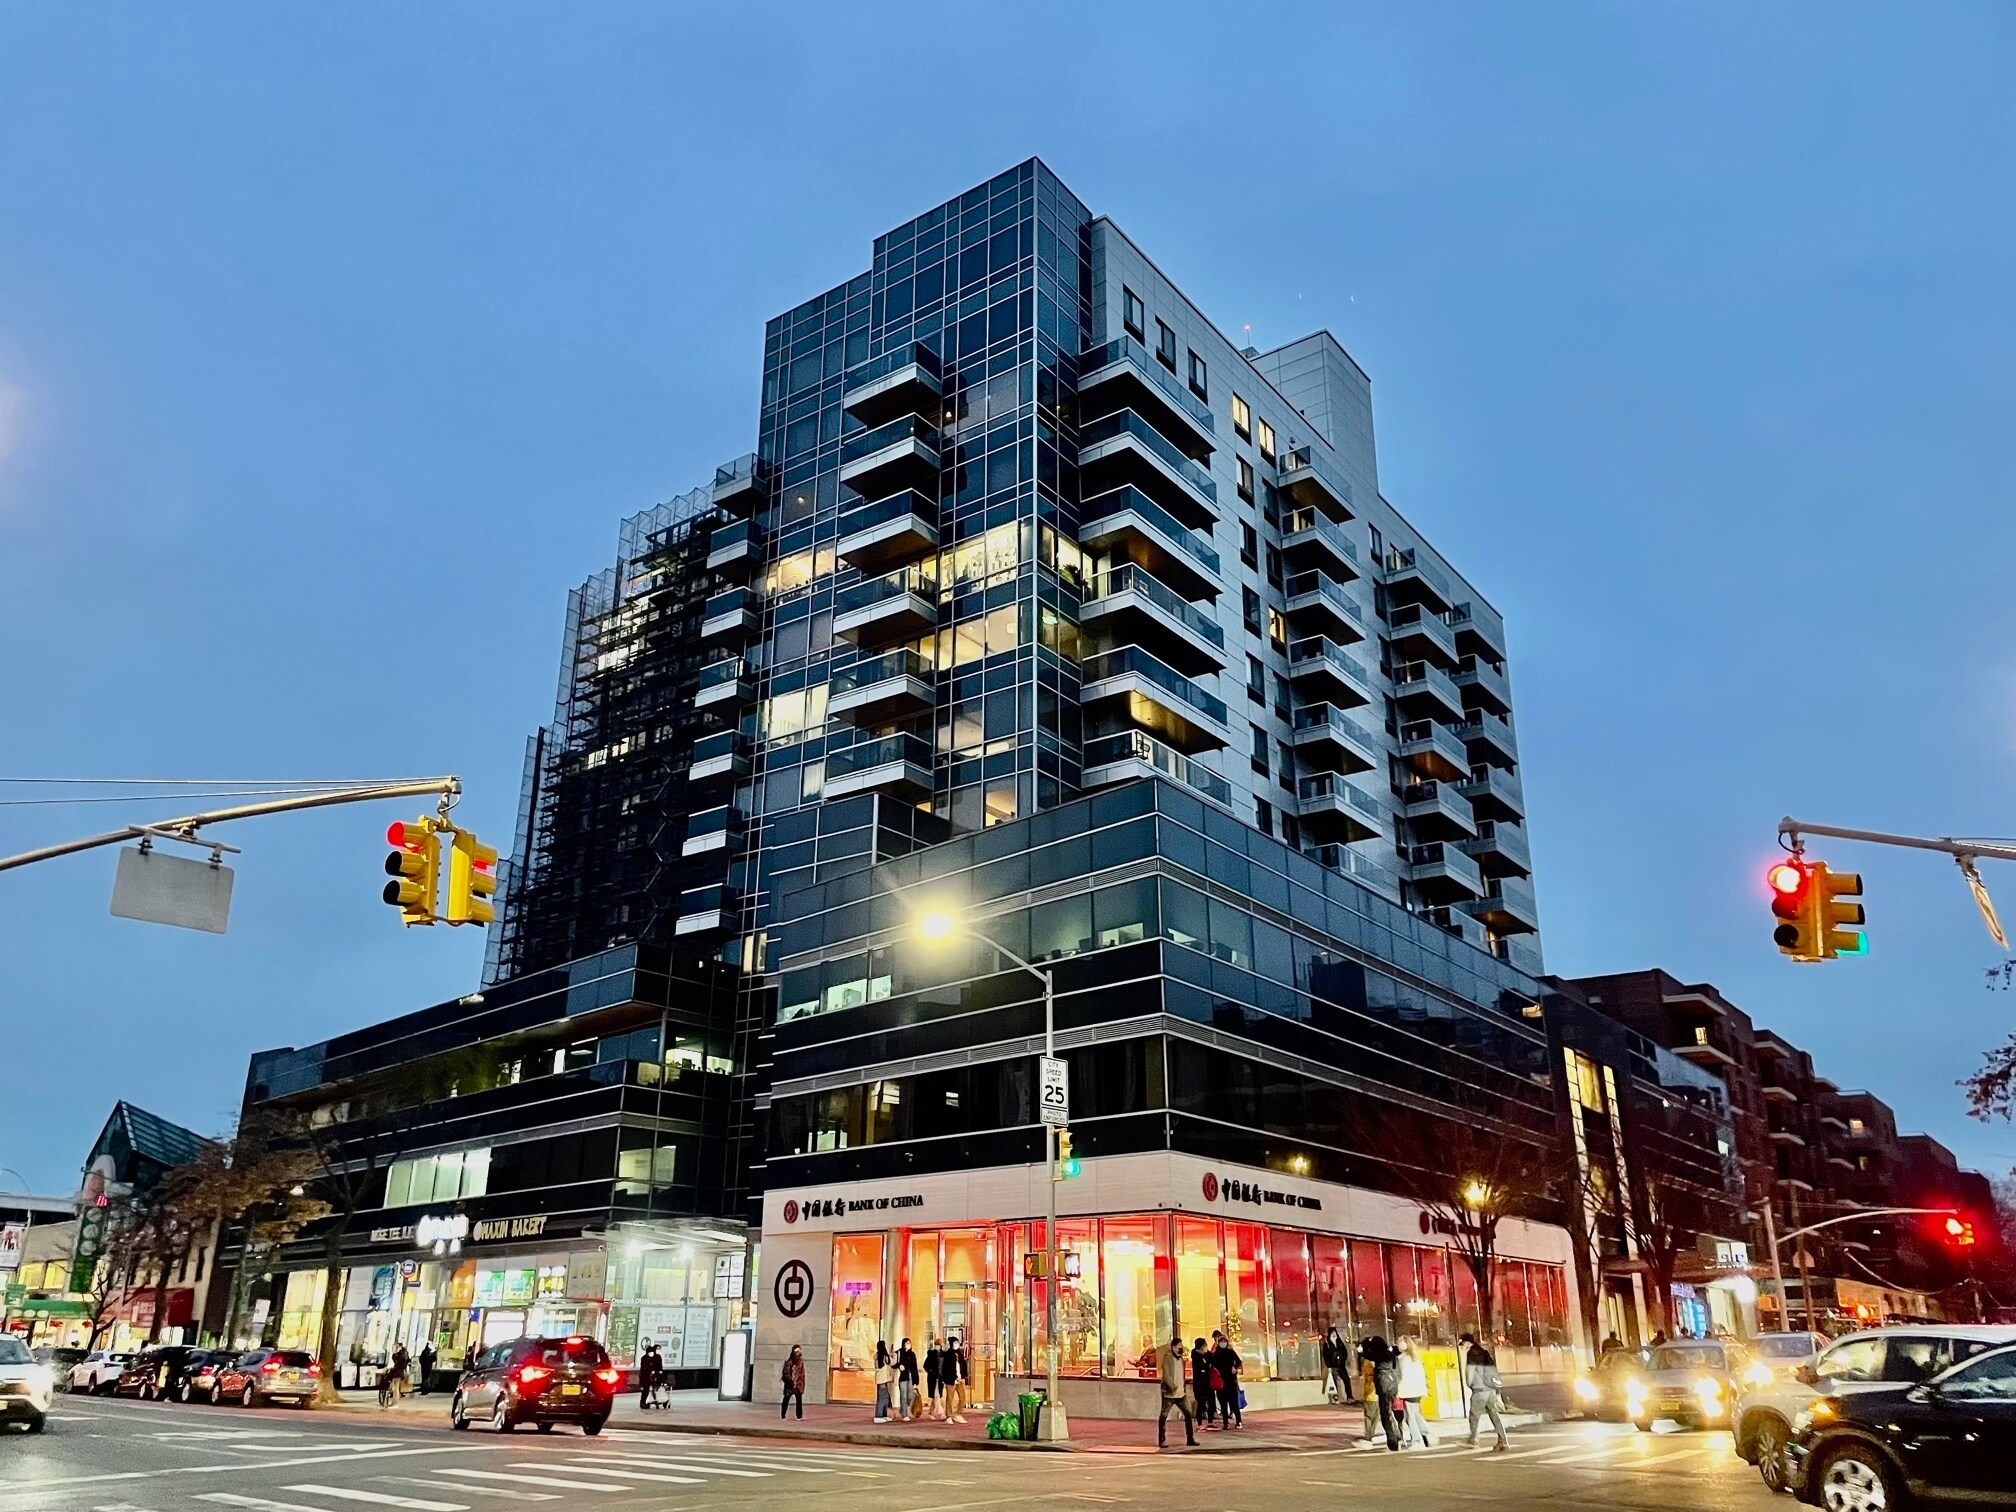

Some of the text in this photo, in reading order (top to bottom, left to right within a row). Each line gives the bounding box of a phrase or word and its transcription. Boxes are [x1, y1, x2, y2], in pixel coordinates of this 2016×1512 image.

[1047, 1061, 1059, 1069] CITY
[1046, 1068, 1062, 1076] SPEED
[1044, 1085, 1065, 1104] 25
[1043, 1115, 1065, 1123] ENFORCED
[848, 1194, 924, 1212] BANK OF CHINA
[511, 1216, 548, 1237] BAKERY
